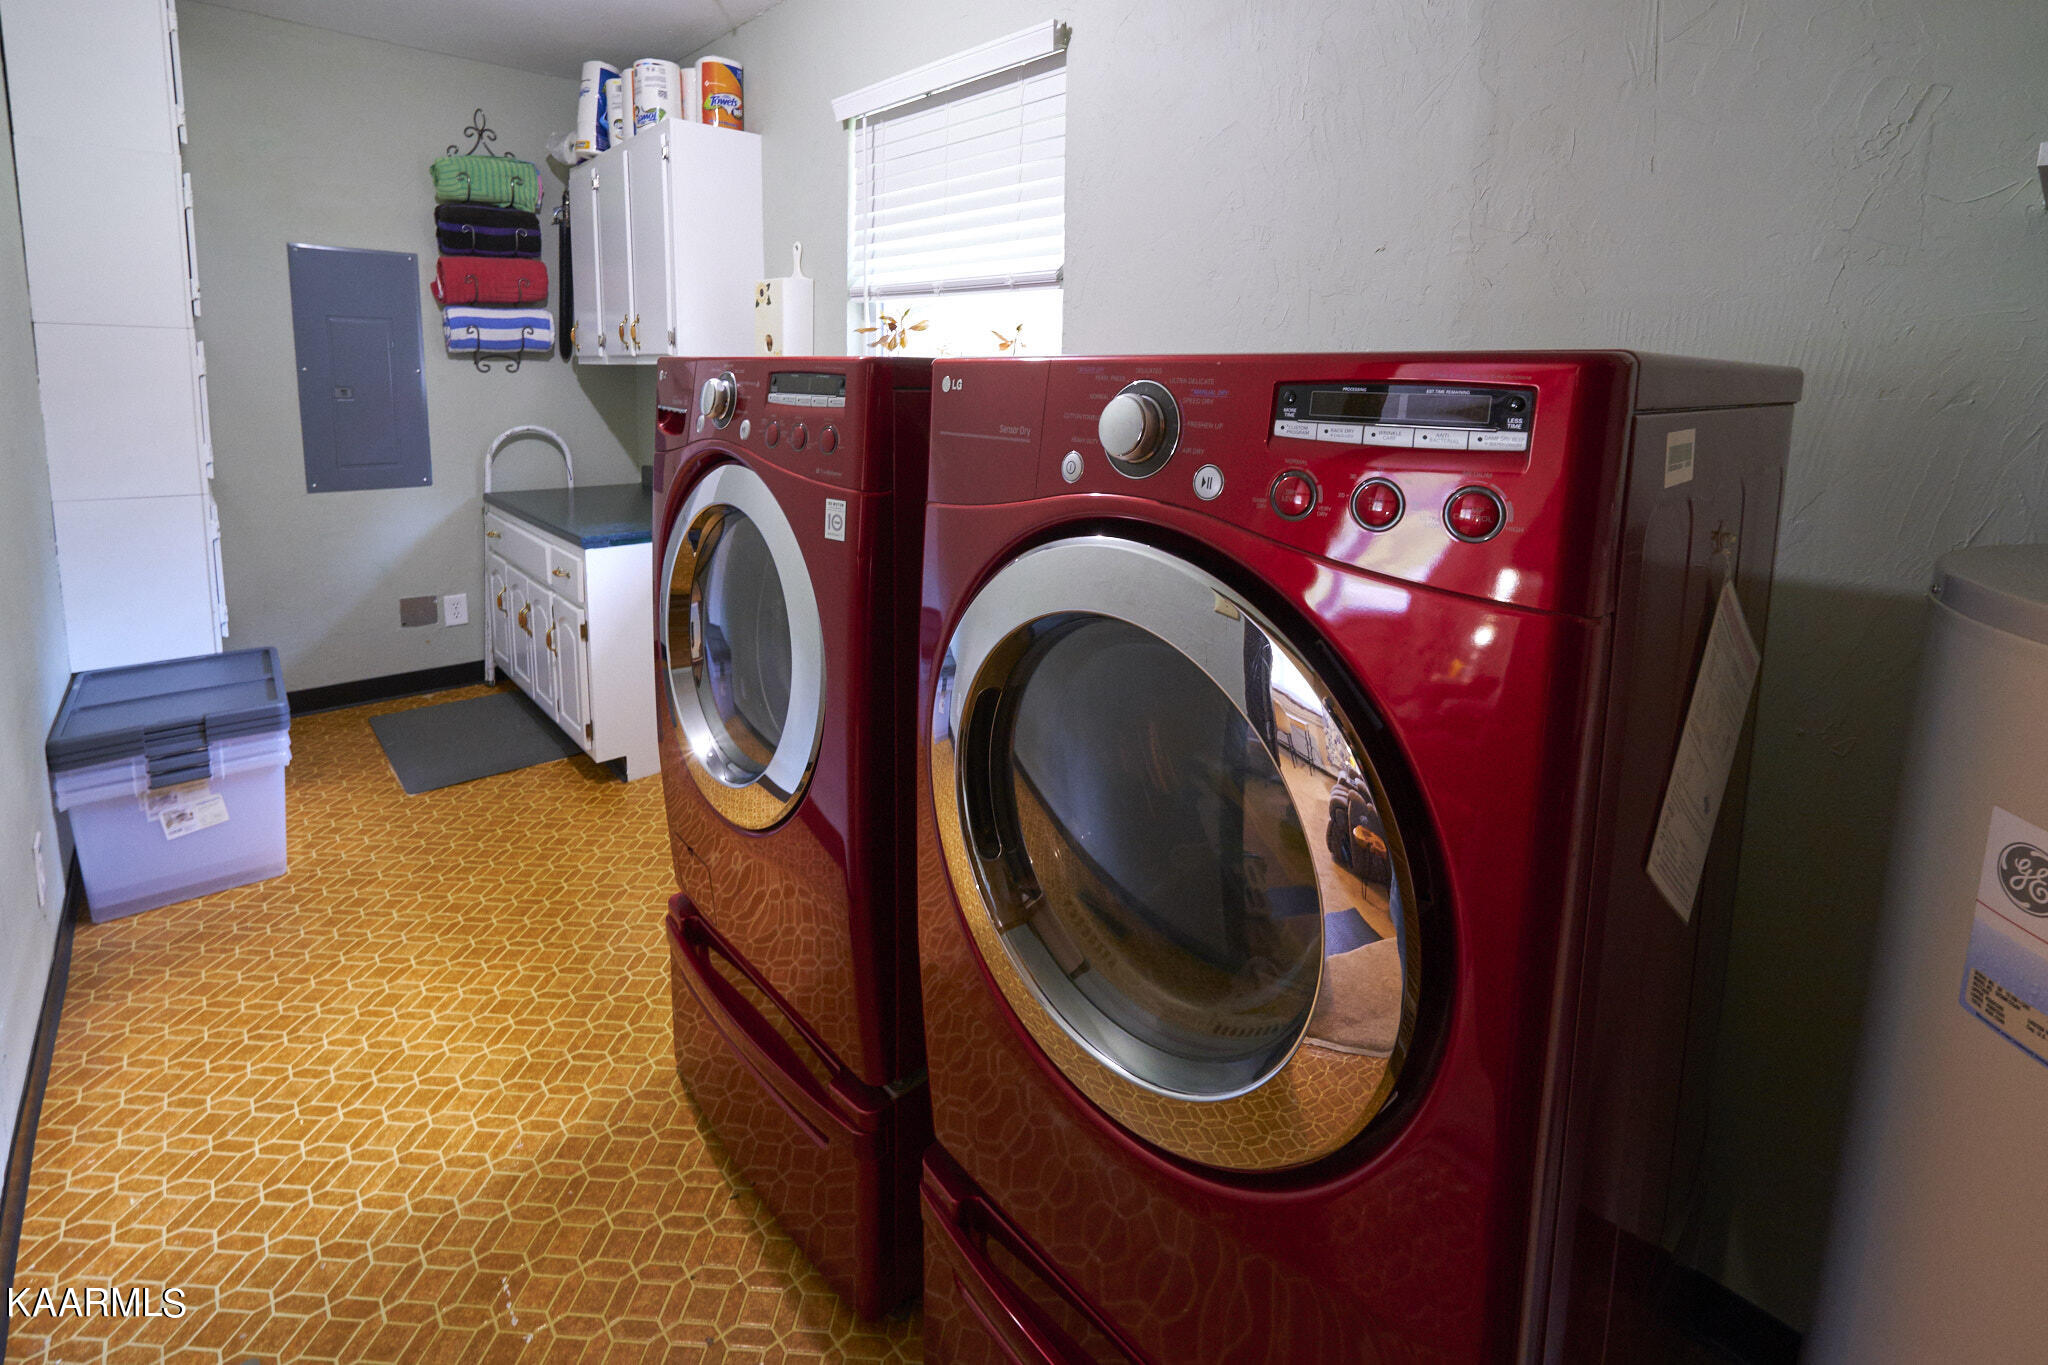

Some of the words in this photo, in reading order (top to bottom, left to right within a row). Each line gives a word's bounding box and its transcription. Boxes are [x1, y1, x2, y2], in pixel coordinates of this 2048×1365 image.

[710, 95, 738, 107] Towels
[951, 378, 963, 391] LG
[1000, 424, 1019, 434] Sensor
[1019, 426, 1031, 436] Dry
